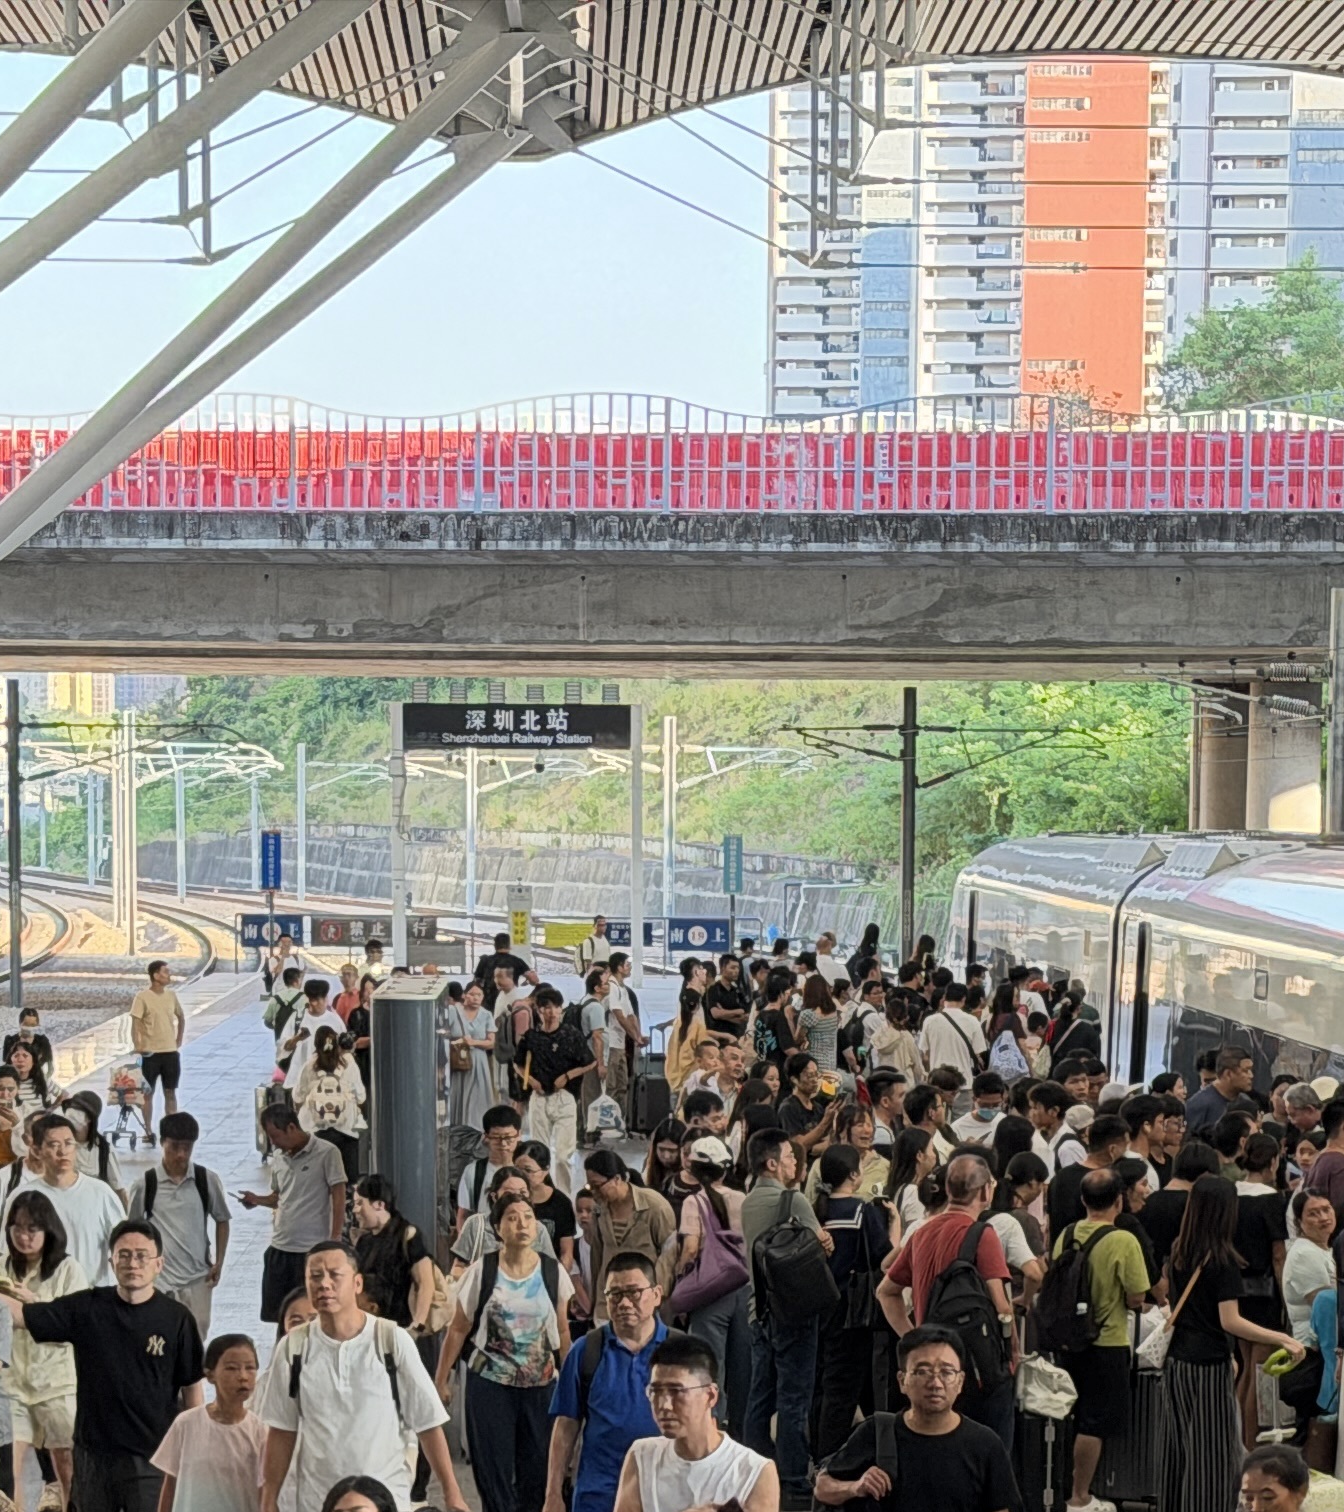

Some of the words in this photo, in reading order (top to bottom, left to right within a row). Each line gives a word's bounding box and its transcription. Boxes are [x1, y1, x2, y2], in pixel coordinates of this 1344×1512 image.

[465, 708, 569, 731] 深圳北站
[441, 732, 510, 744] Shenzhenbei
[512, 732, 554, 746] Railway
[556, 732, 593, 744] Station
[349, 920, 428, 937] 禁止行
